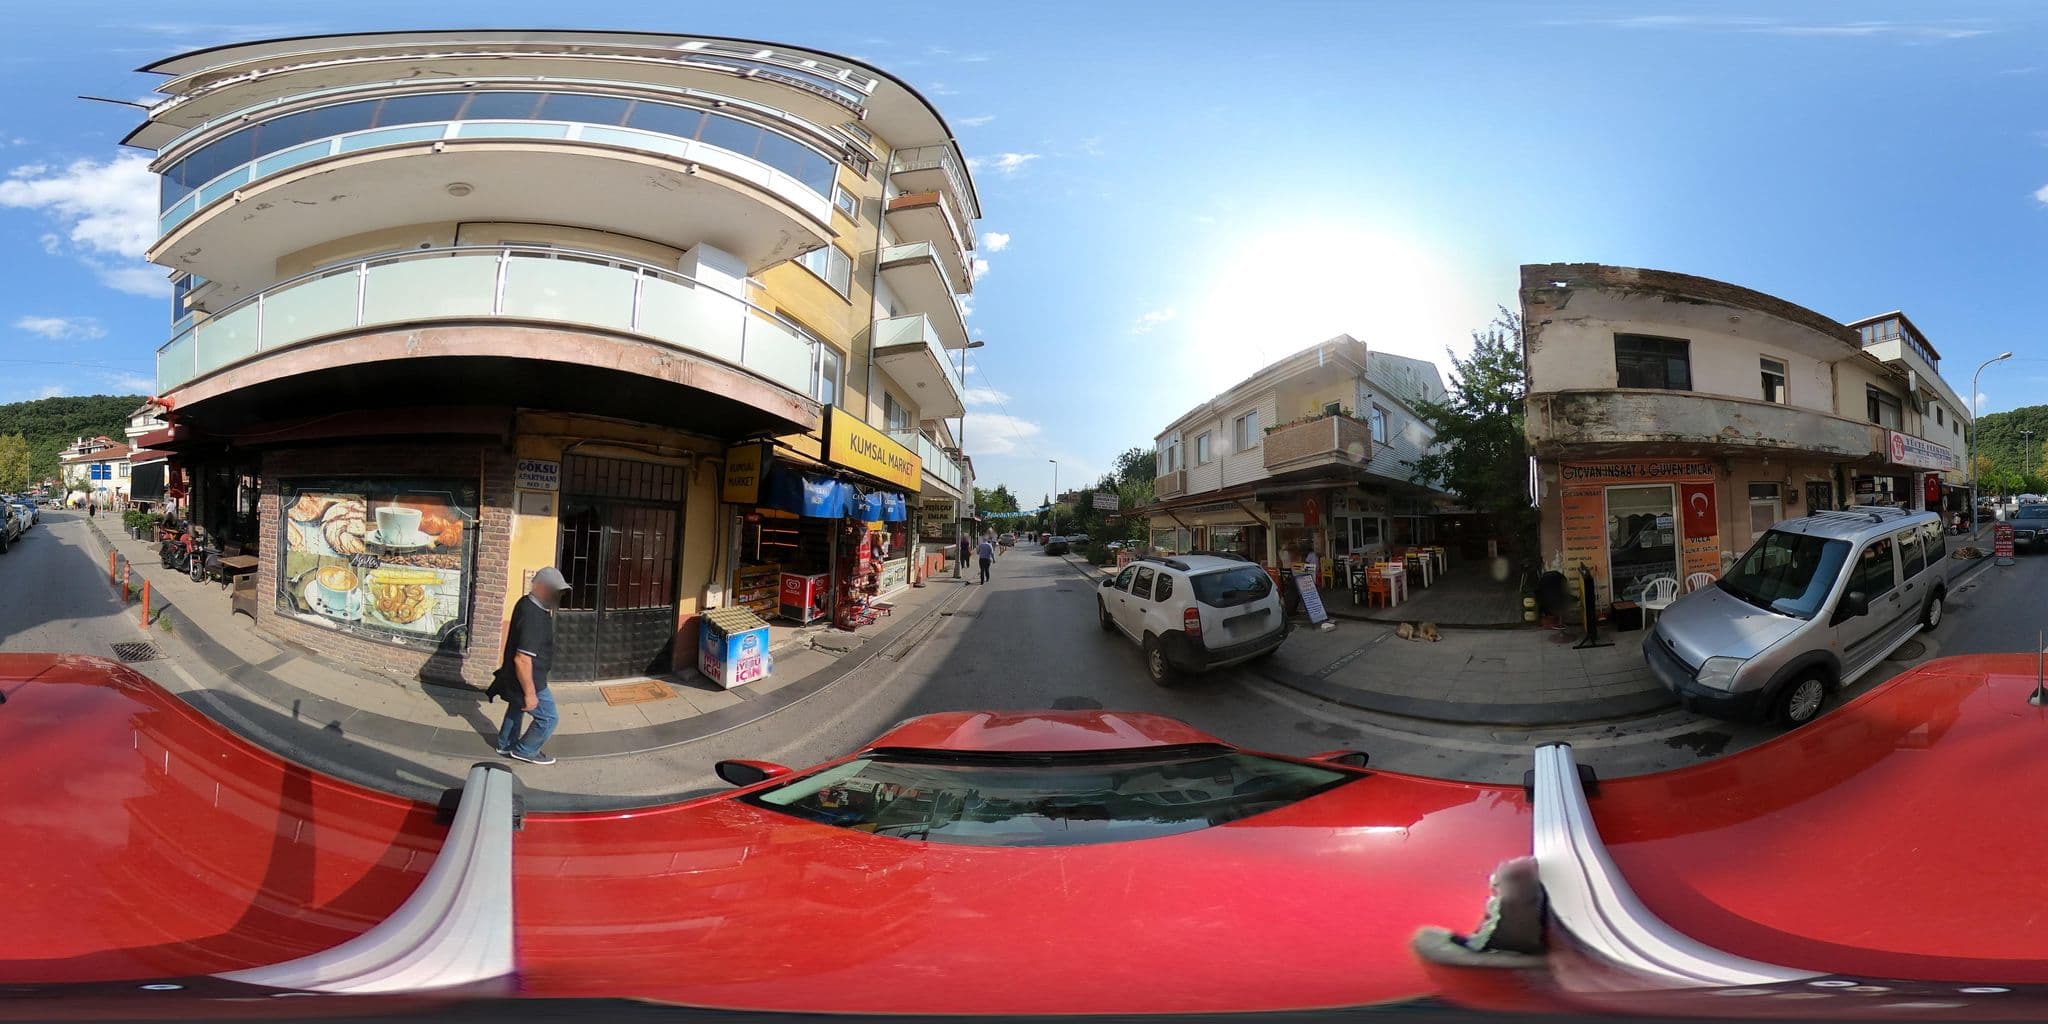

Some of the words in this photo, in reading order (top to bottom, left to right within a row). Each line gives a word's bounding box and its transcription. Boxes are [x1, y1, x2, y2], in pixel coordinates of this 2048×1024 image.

[850, 432, 887, 465] KUMSAL
[888, 453, 914, 477] MARKET
[1686, 463, 1713, 475] EMLAK
[728, 476, 753, 487] MARKET
